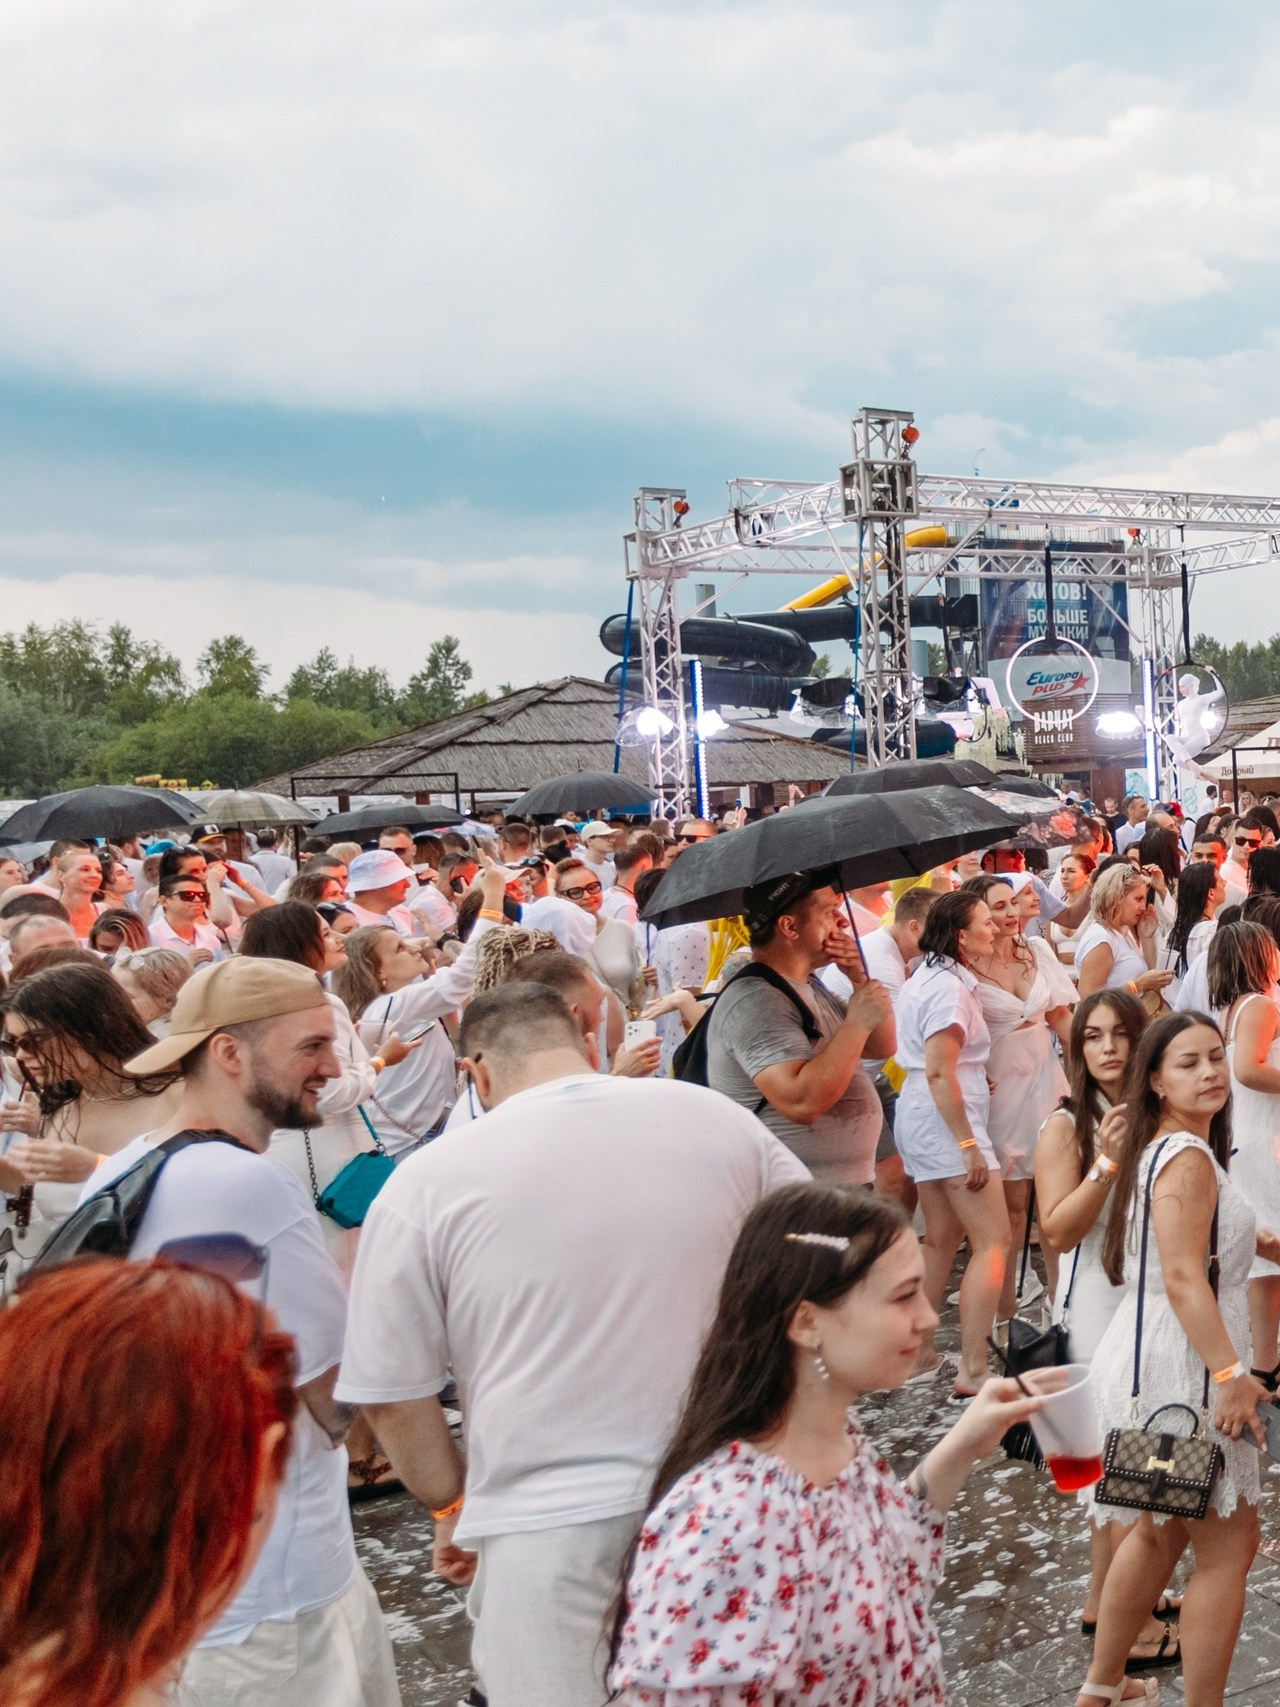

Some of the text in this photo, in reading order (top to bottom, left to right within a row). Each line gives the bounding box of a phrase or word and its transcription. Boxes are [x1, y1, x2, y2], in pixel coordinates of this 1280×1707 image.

[1028, 626, 1089, 639] МУЫКИ!
[1026, 671, 1080, 686] Europa
[1057, 733, 1073, 743] CLUB
[1221, 765, 1255, 777] Дорый
